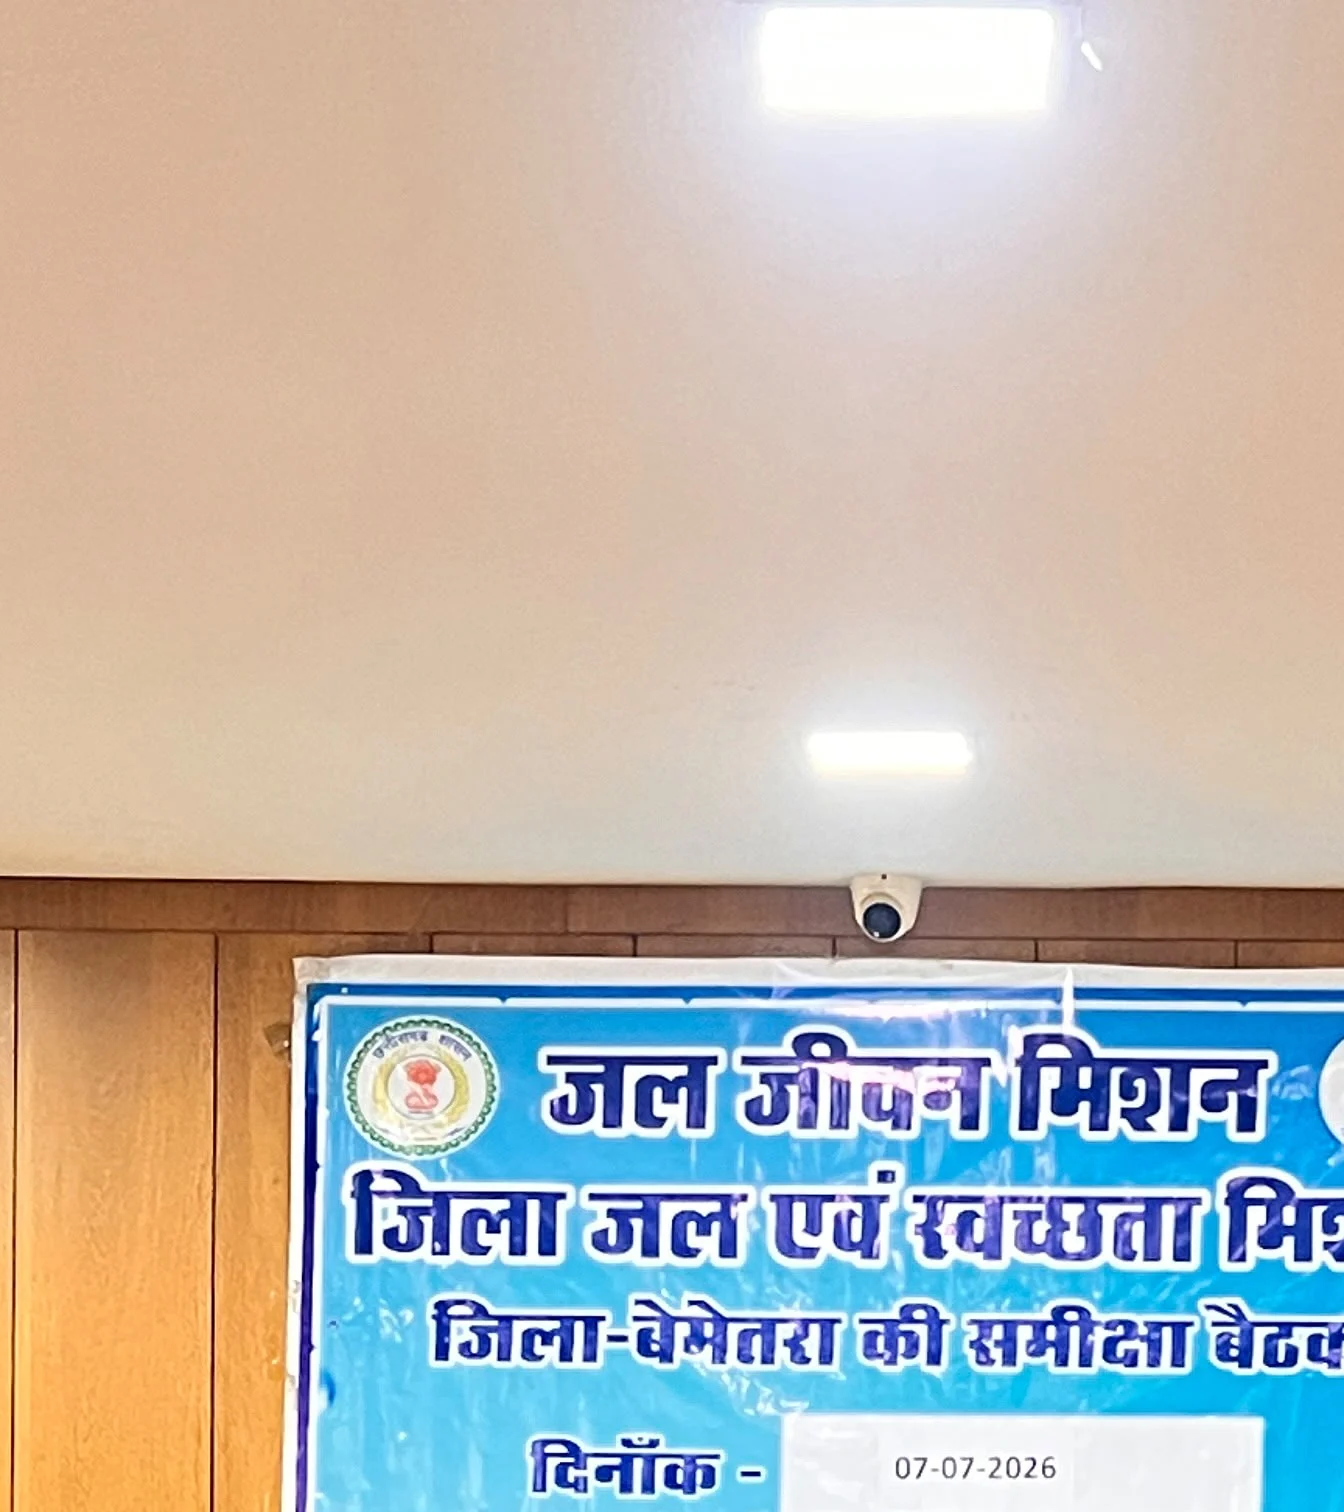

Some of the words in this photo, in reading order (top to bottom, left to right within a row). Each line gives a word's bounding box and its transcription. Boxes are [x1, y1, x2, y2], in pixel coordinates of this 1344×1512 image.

[546, 1055, 718, 1129] जल
[741, 1032, 992, 1131] जीवन
[1015, 1033, 1269, 1133] मिशन
[350, 1169, 567, 1256] जिला
[588, 1192, 748, 1259] जल
[769, 1170, 895, 1259] एवं
[912, 1194, 1202, 1262] स्वच्छता
[431, 1299, 842, 1365] जिला-बेमेतरा
[858, 1303, 949, 1366] की
[969, 1305, 1194, 1368] समीक्षा
[895, 1456, 1057, 1480] 07-07-2026
